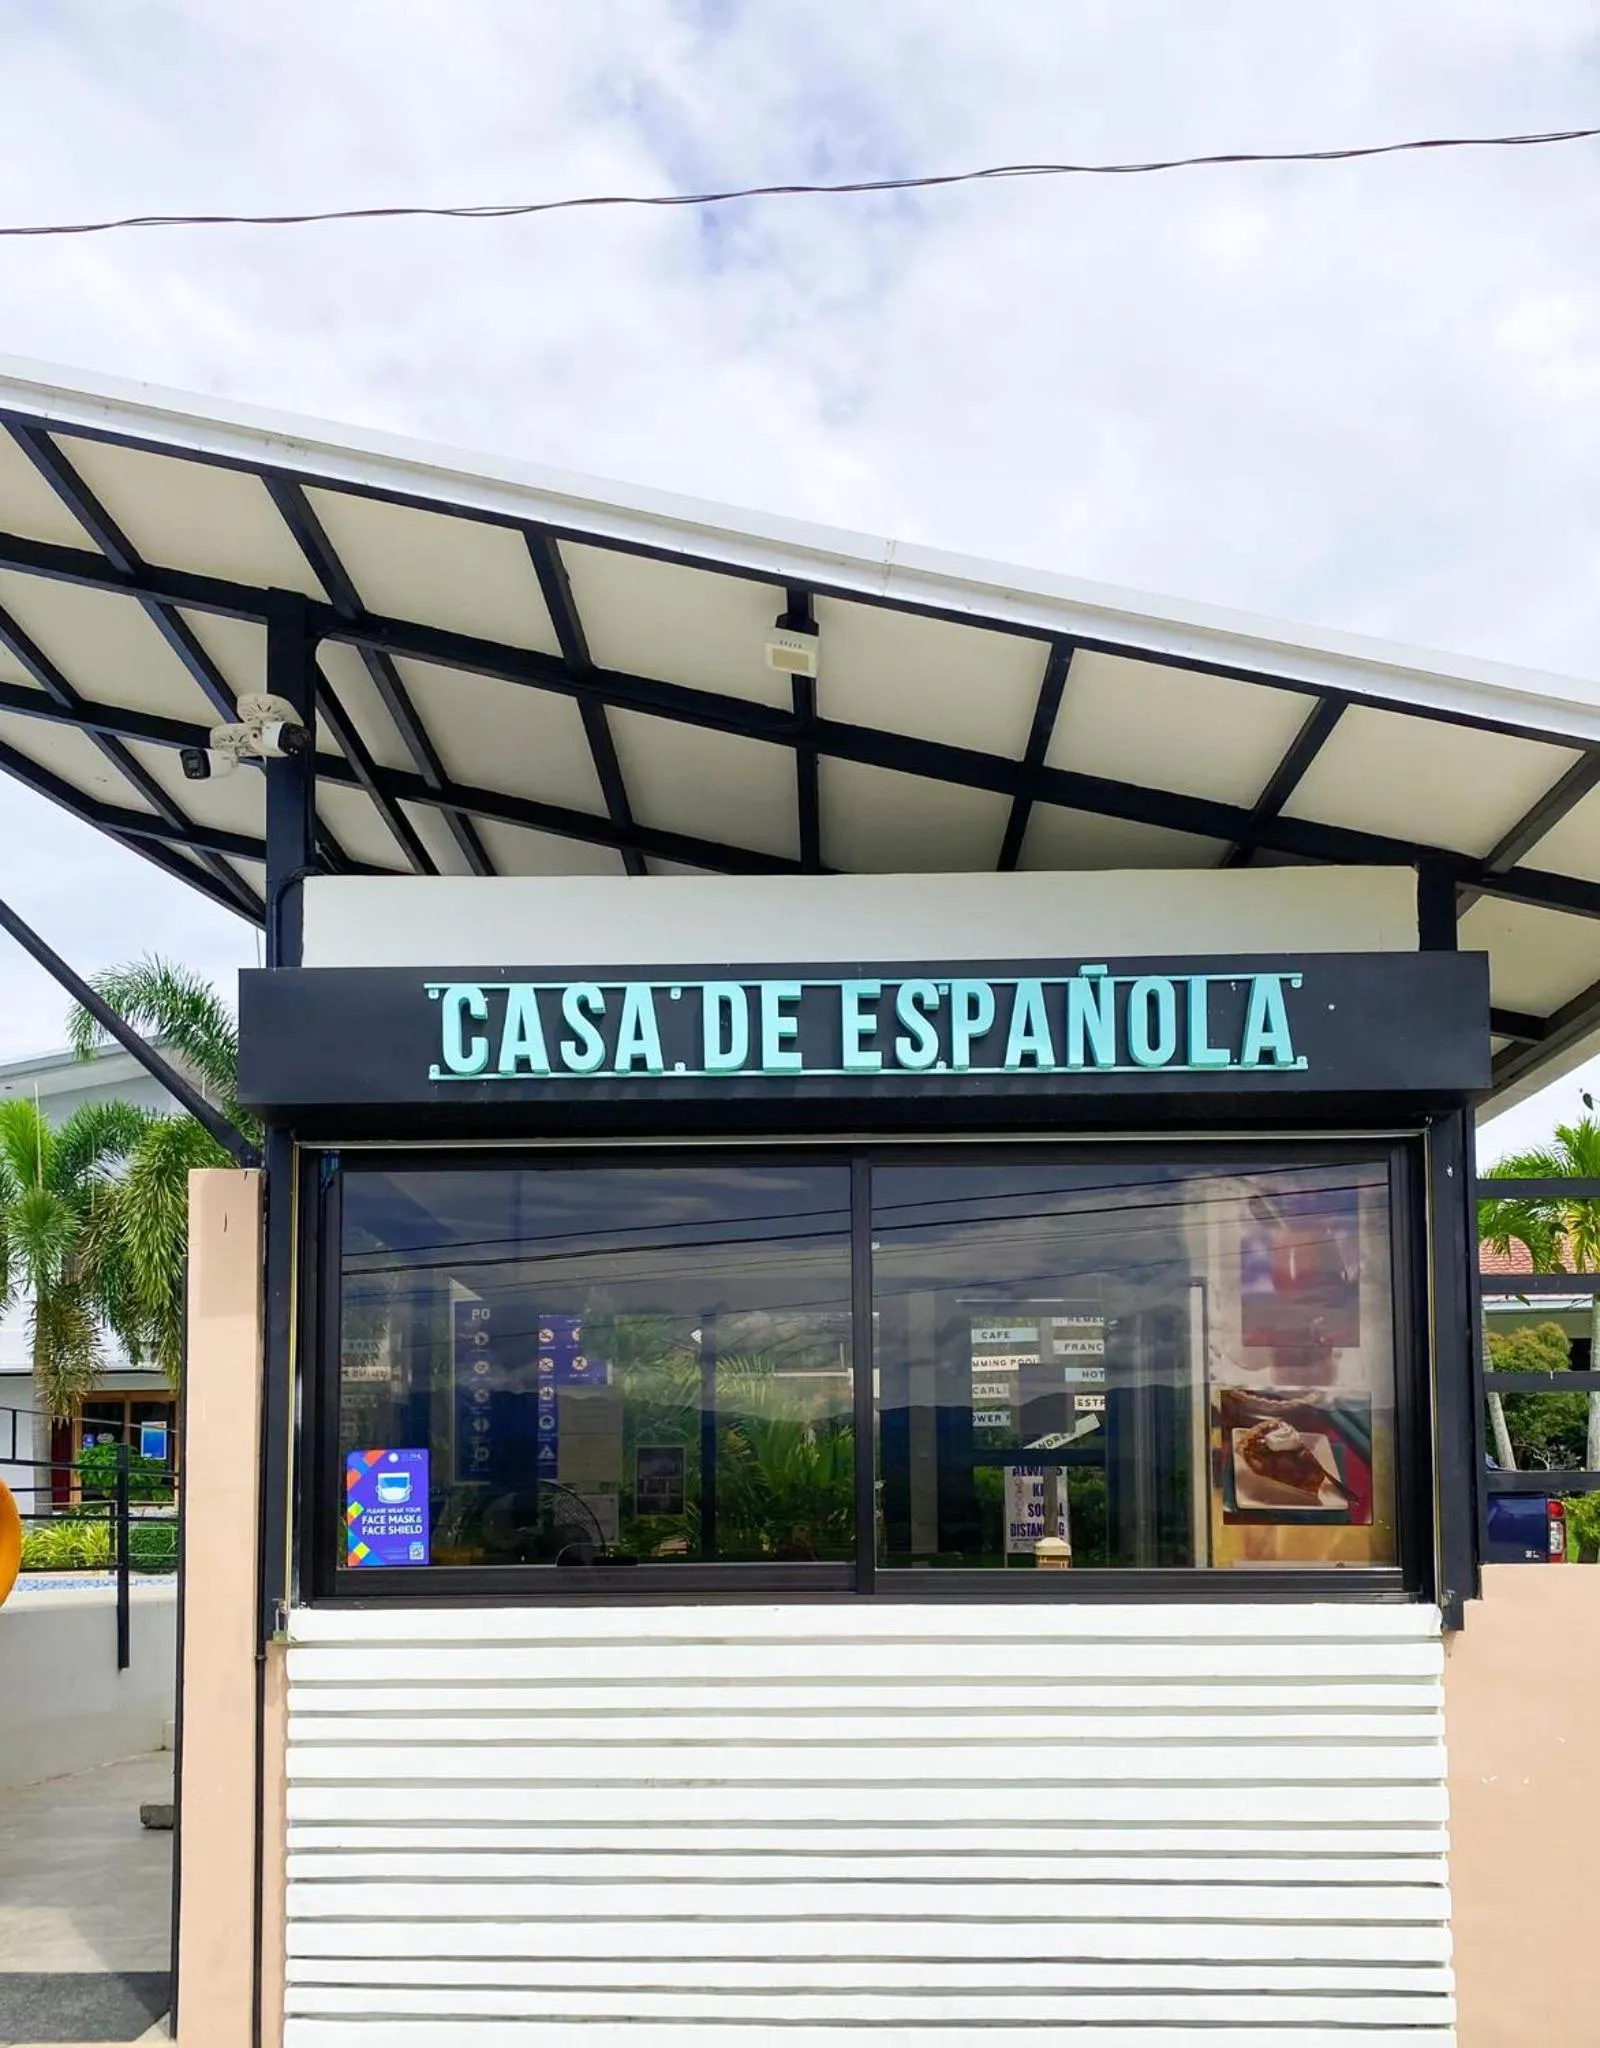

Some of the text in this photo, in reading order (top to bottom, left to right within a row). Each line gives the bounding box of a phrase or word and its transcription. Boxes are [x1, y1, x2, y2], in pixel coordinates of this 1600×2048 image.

[443, 965, 1295, 1074] CASA DE ESPAÑOLA
[981, 1331, 1011, 1340] CAFE
[1064, 1343, 1104, 1352] FRANC
[362, 1515, 386, 1524] FACE
[362, 1525, 423, 1535] FACE SHIELD
